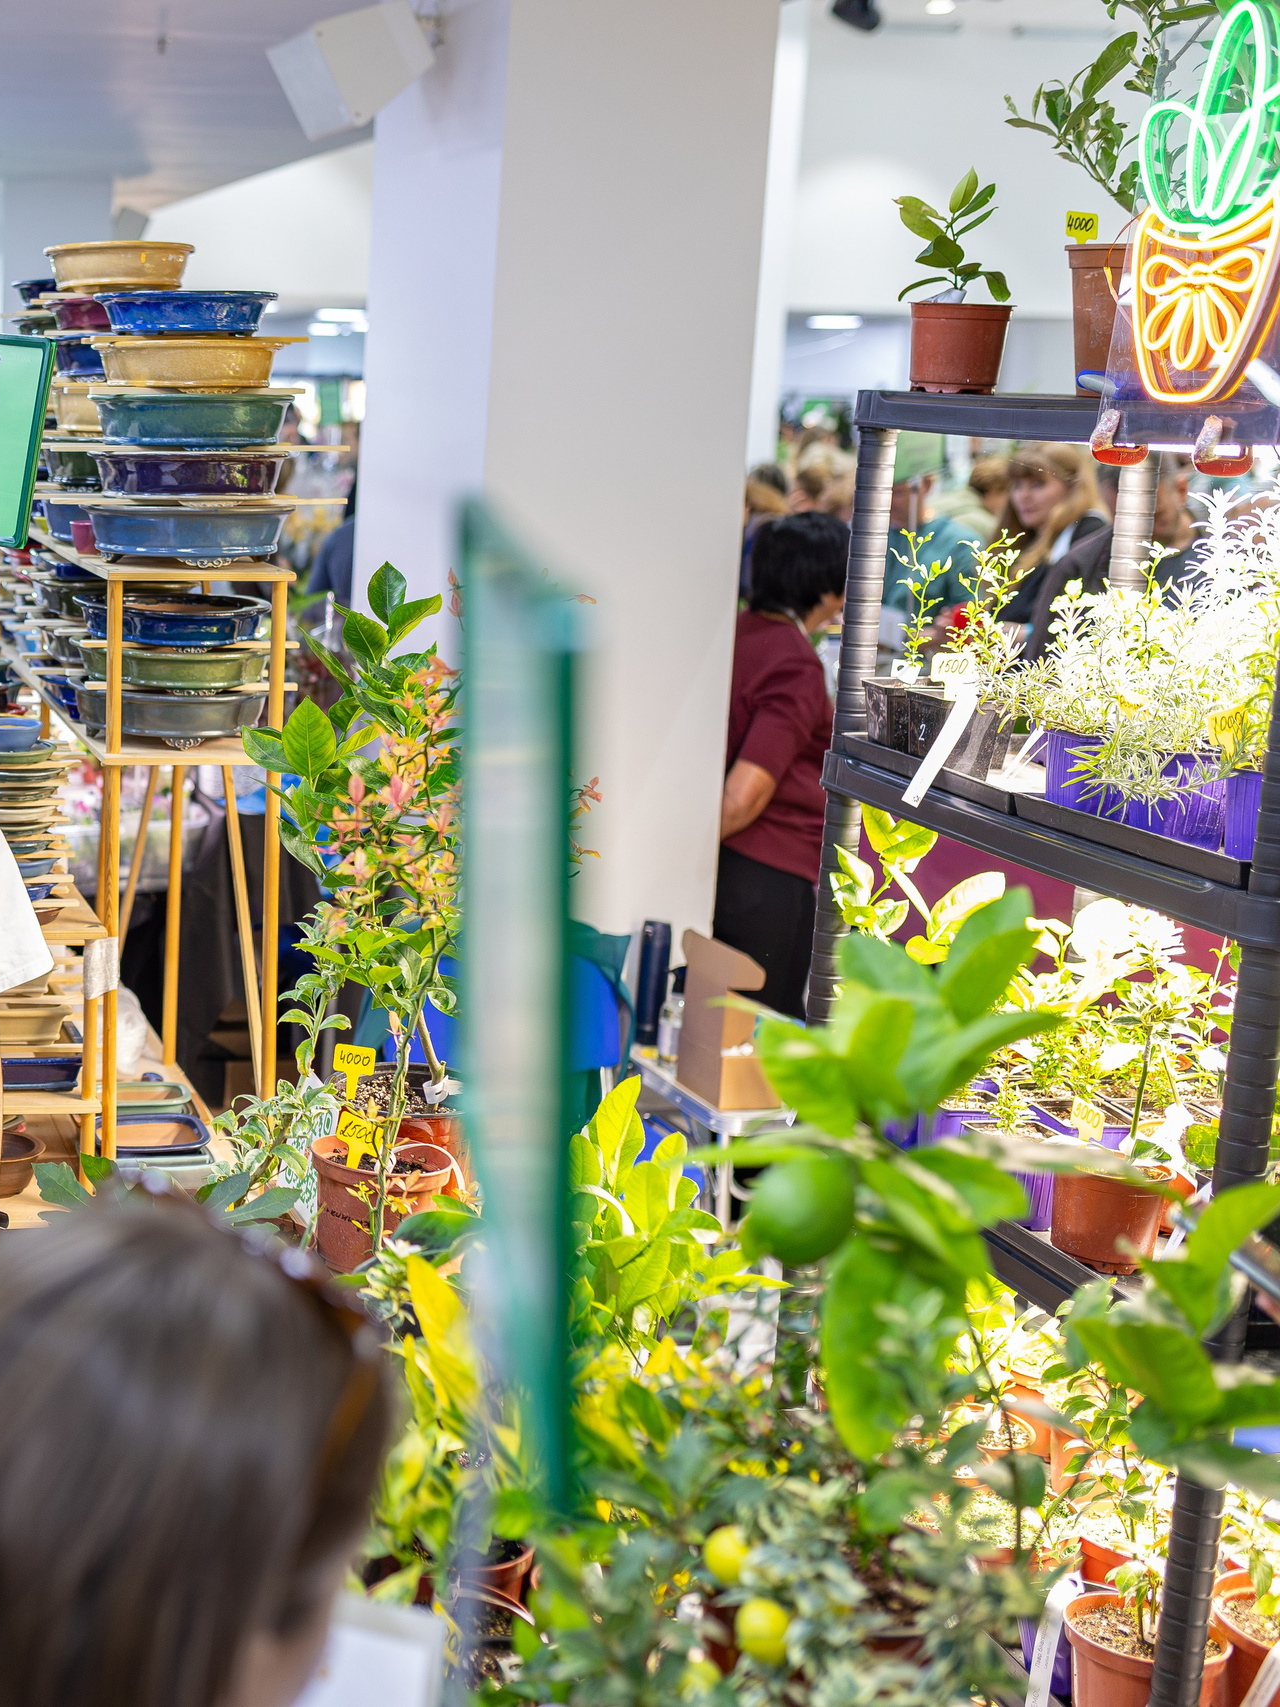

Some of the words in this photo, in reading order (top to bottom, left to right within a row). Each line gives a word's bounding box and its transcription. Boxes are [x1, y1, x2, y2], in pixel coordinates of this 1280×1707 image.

[1067, 214, 1094, 232] 4000
[938, 658, 969, 675] 1500
[918, 723, 926, 741] 2
[340, 1050, 370, 1066] 4000
